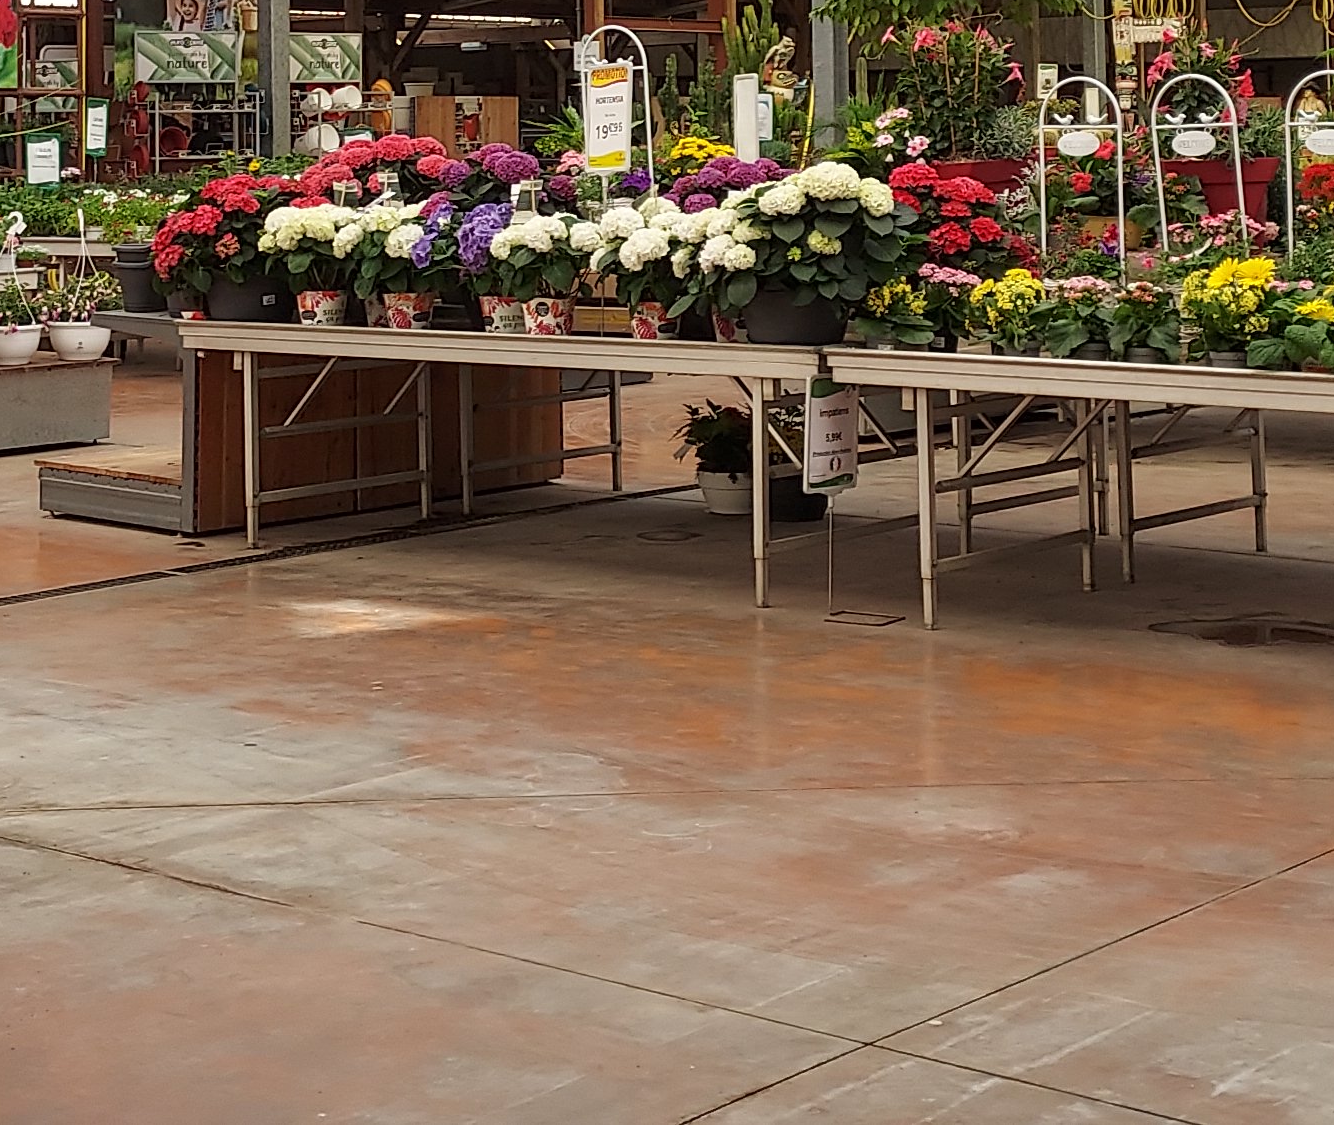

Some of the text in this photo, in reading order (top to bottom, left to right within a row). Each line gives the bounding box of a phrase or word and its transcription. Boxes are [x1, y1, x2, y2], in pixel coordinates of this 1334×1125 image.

[166, 57, 208, 69] nature
[309, 57, 340, 69] nature
[595, 95, 624, 105] HORTENSIA
